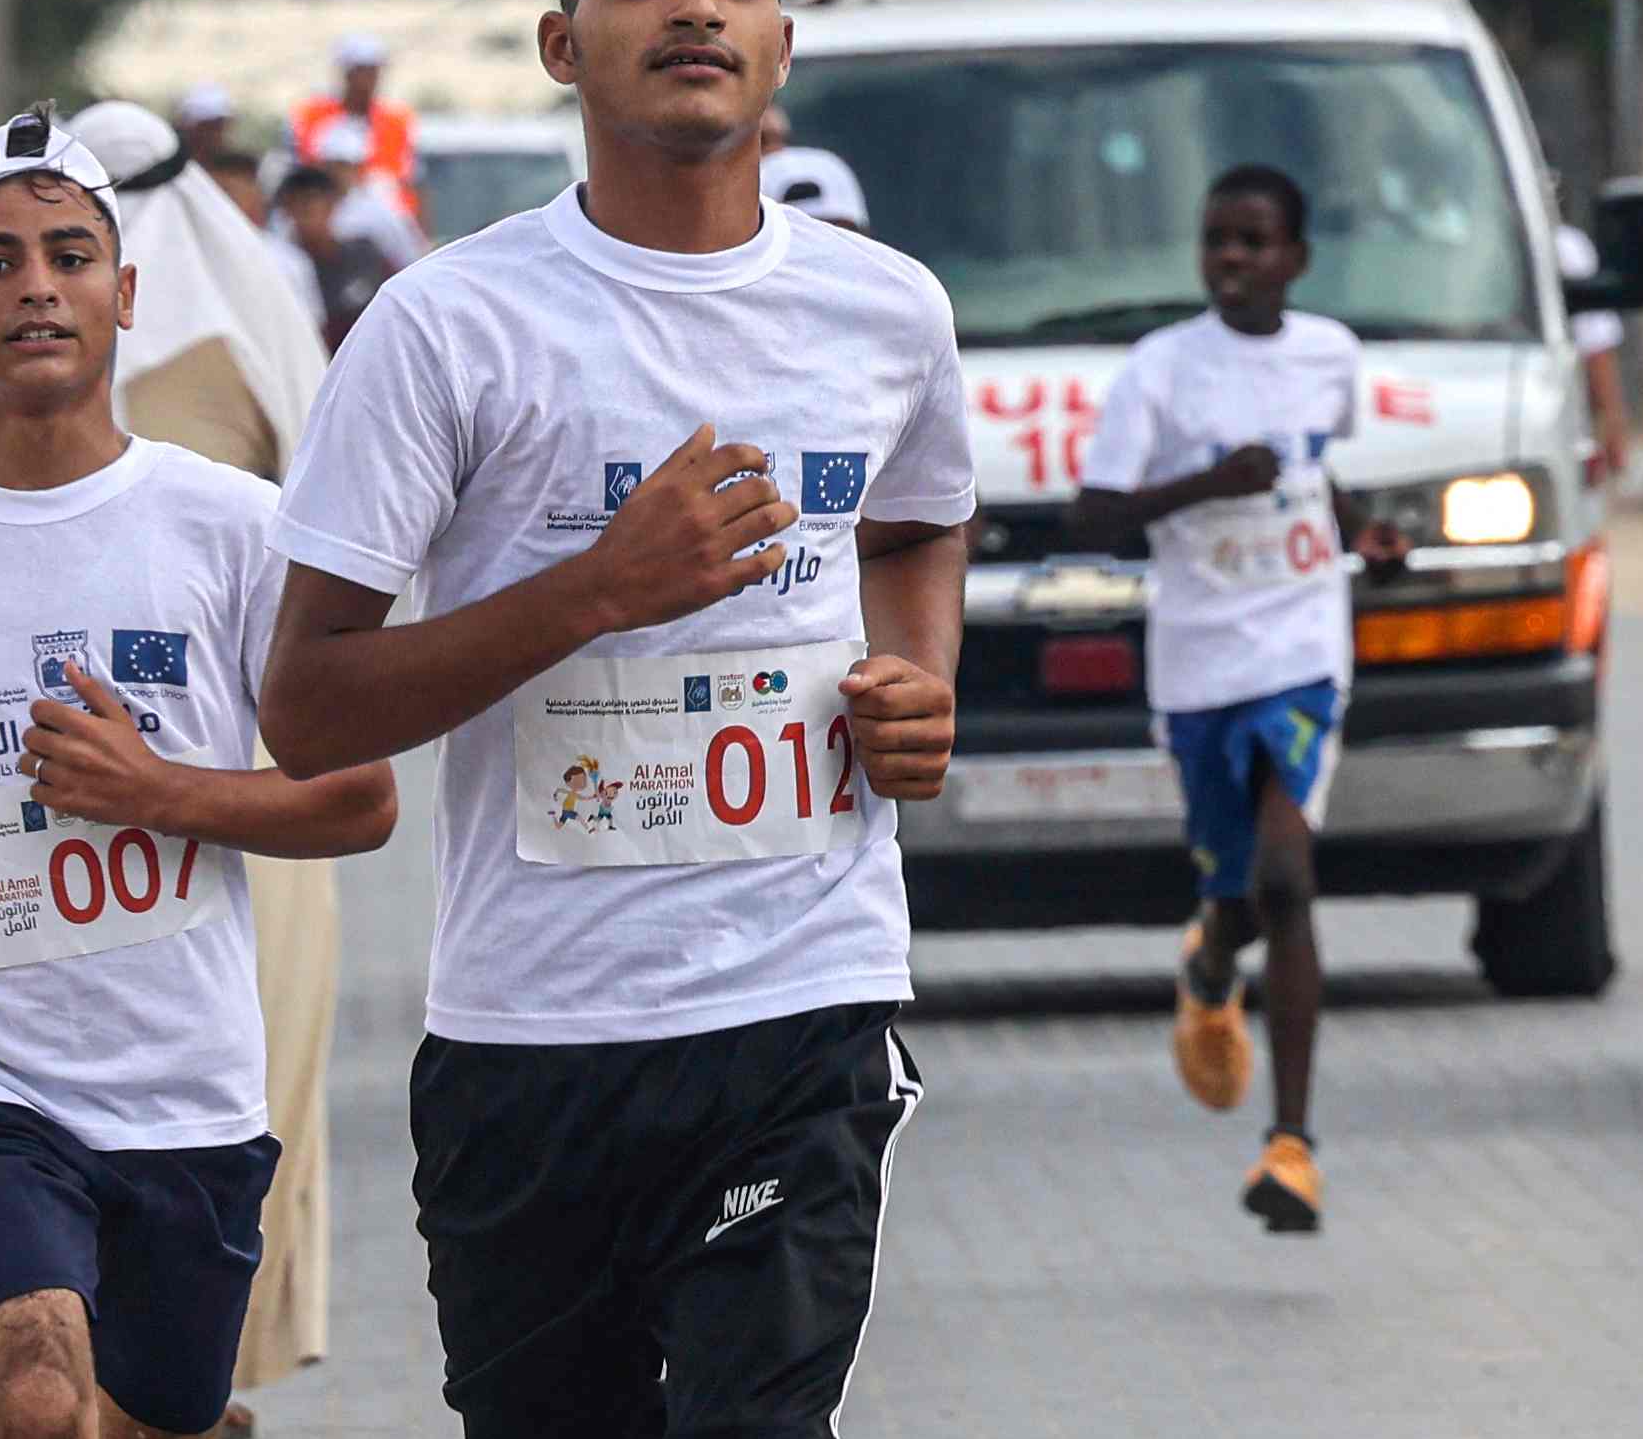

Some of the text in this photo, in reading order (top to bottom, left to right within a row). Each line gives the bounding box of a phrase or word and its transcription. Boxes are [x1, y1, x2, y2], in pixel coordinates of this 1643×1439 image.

[799, 519, 838, 532] European
[634, 762, 693, 779] Al Amal
[705, 714, 855, 826] 012
[630, 778, 695, 791] MARATHON
[636, 791, 689, 811] ماراثون
[642, 809, 682, 830] الأمل
[7, 875, 41, 892] Amal
[4, 916, 38, 937] الأمل
[723, 1178, 780, 1219] NIKE
